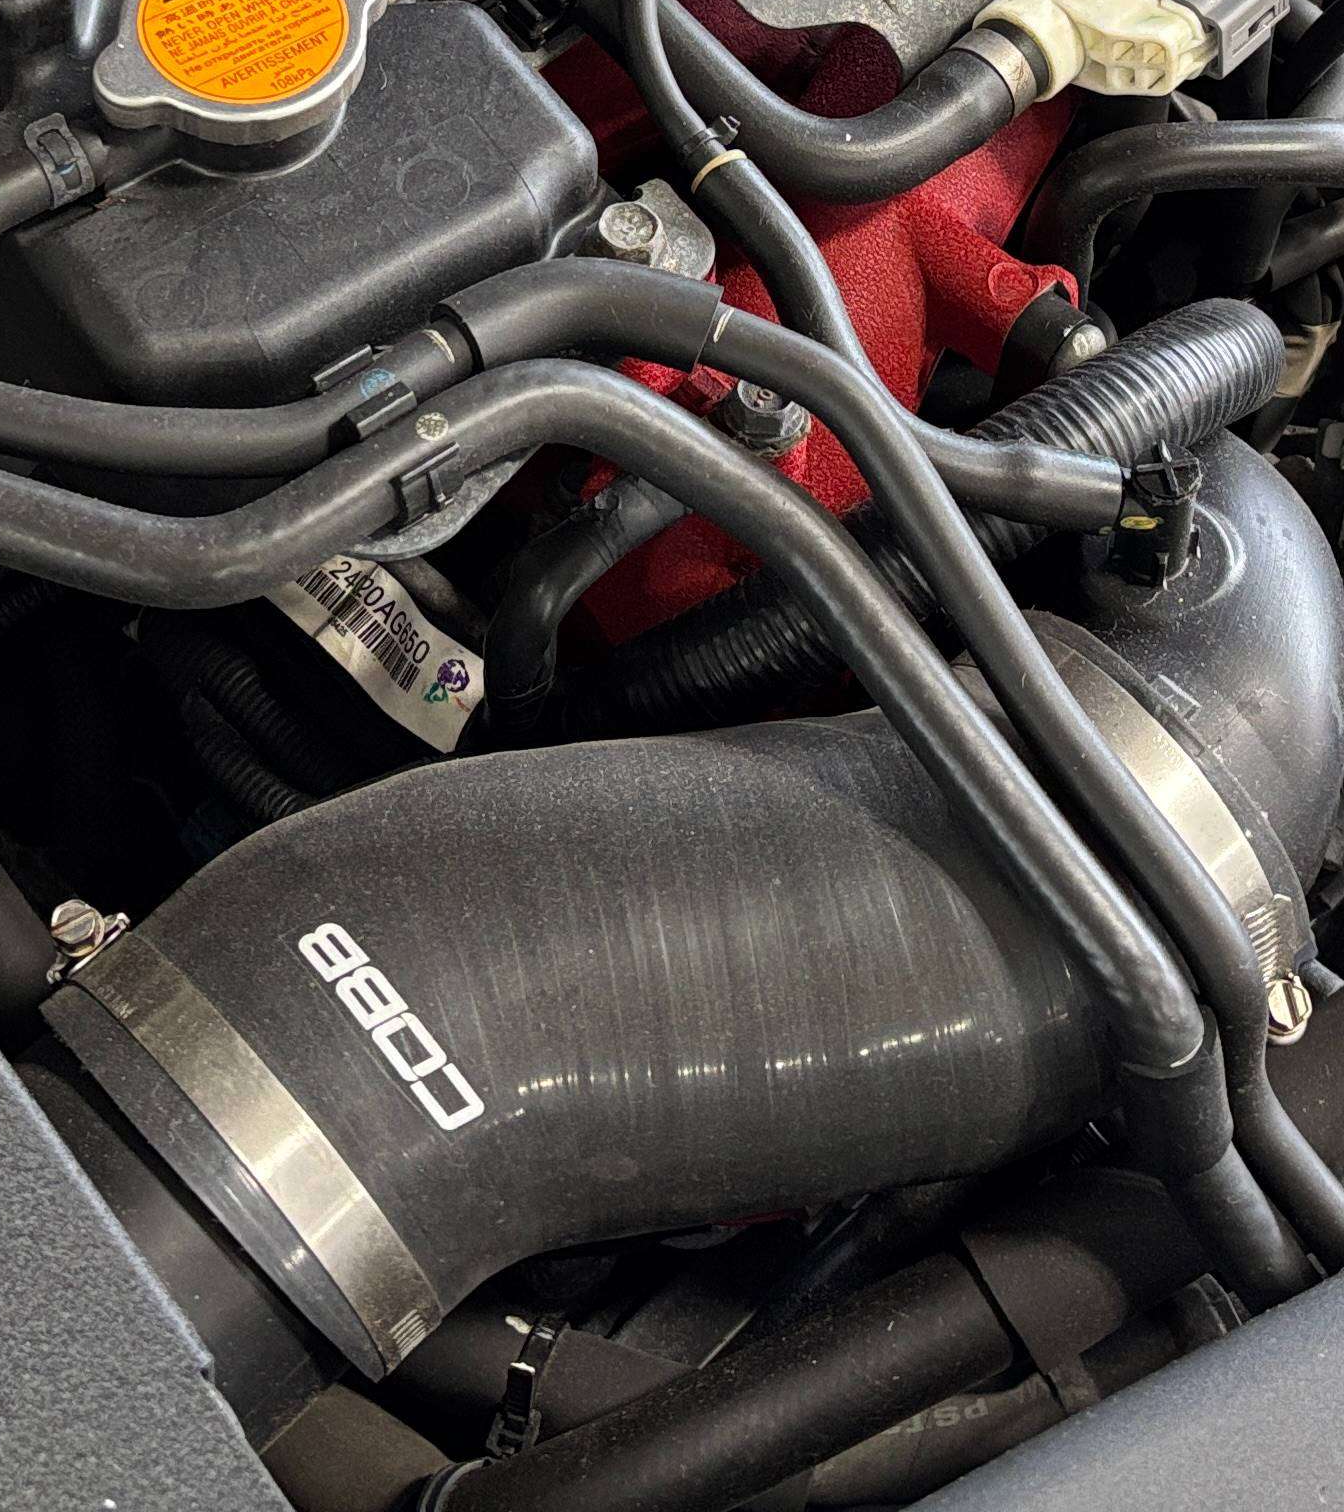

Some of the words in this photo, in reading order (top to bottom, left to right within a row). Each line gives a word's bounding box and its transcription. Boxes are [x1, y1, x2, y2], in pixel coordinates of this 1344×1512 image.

[161, 26, 203, 49] NEVER
[206, 10, 240, 29] OPEN
[188, 28, 226, 50] JAMAIS
[227, 10, 266, 32] OUVRIR
[221, 31, 327, 87] AVERTISSEMENT
[270, 67, 314, 89] 108kPa
[298, 922, 485, 1131] COBB
